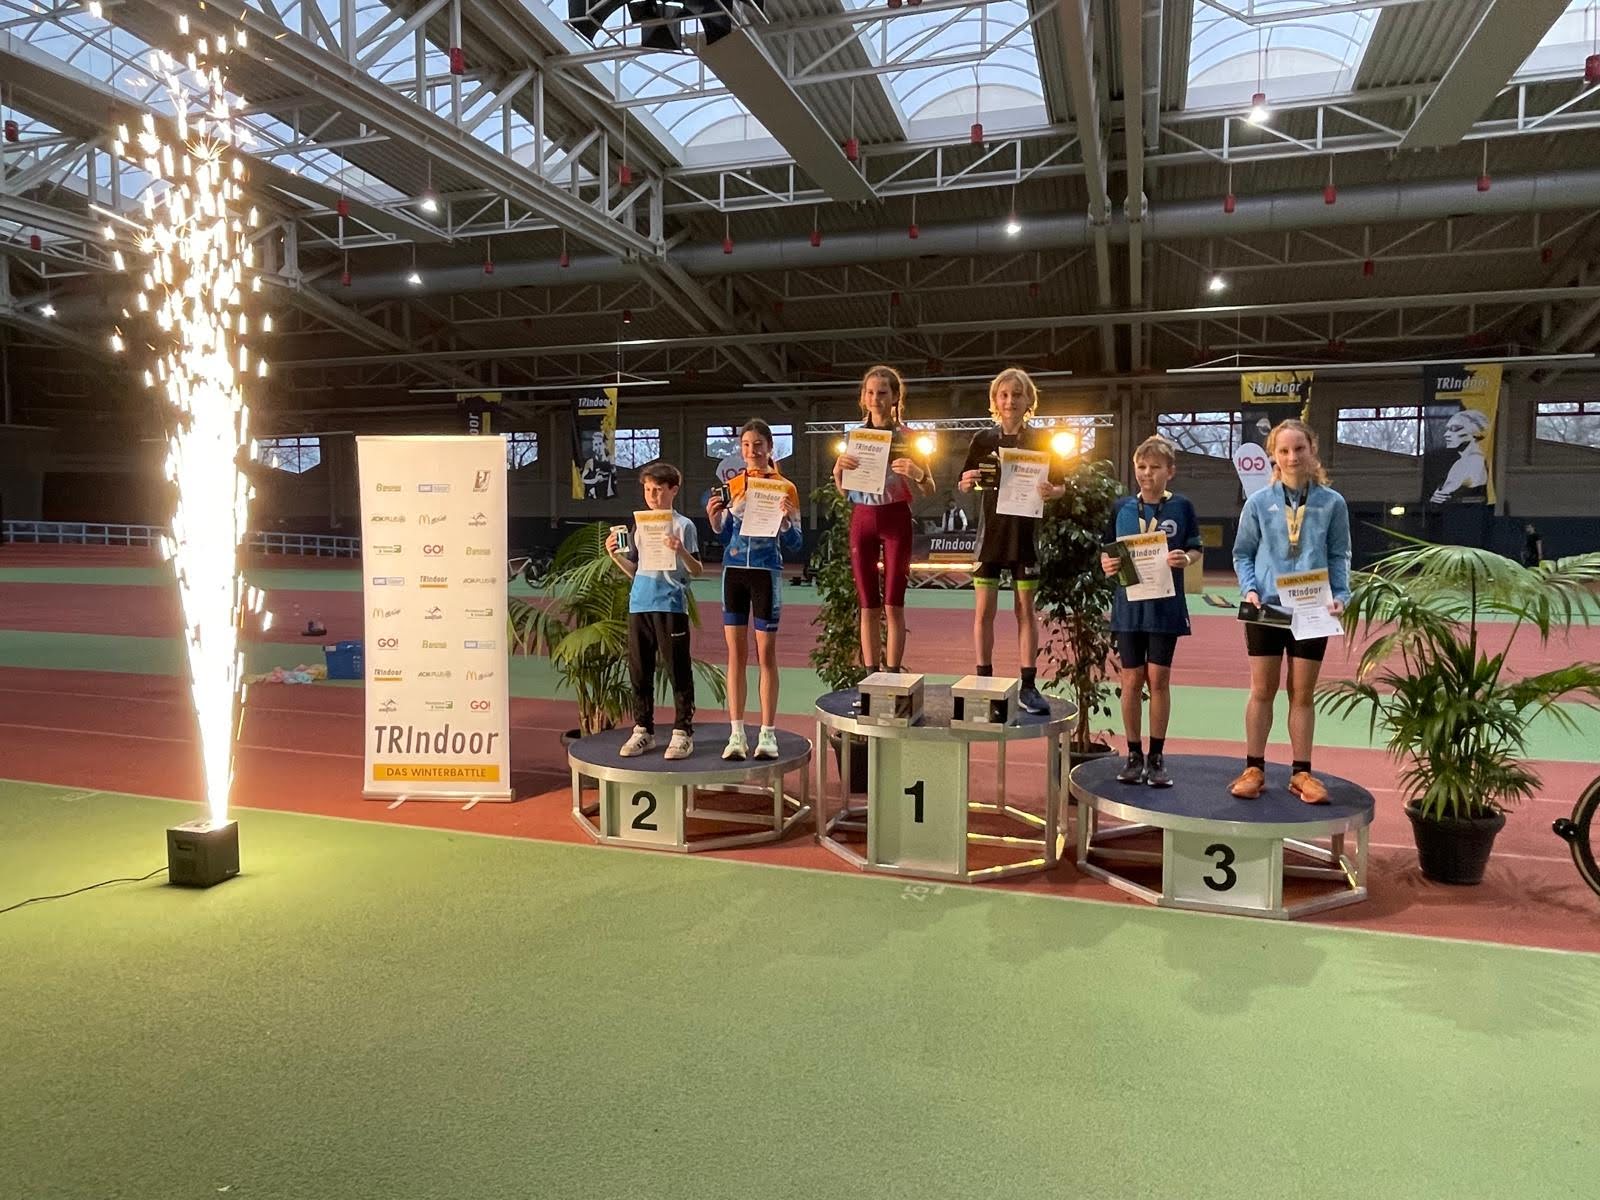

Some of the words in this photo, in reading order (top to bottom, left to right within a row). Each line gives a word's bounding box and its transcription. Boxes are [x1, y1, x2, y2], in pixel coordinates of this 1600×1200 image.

[423, 544, 444, 554] GO!
[930, 538, 976, 550] TRIndoor
[420, 575, 448, 583] TRIndoor
[1288, 587, 1322, 598] TRIndoor
[377, 638, 399, 648] GO!
[374, 668, 402, 676] TRIndoor
[470, 700, 491, 710] GO!
[374, 723, 499, 755] TRIndoor
[386, 767, 408, 777] DAS
[411, 767, 487, 778] WINTERBATTLE
[904, 780, 925, 823] 1
[631, 790, 658, 831] 2
[1202, 843, 1237, 891] 3
